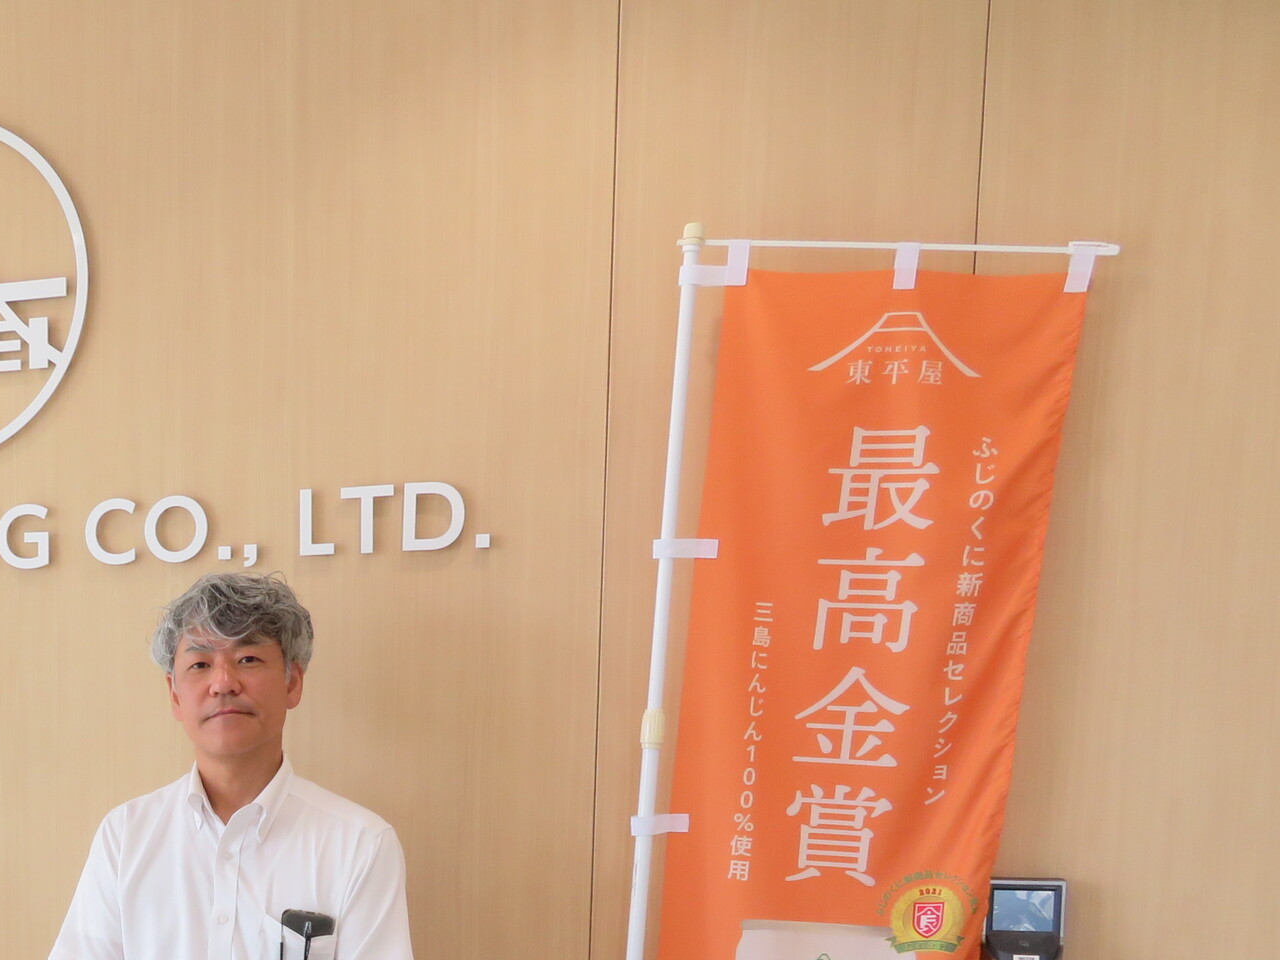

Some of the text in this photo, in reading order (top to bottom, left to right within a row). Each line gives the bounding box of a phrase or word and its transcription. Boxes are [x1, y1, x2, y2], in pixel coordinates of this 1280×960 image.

[845, 358, 944, 386] 東平屋
[866, 345, 928, 354] TOHEIYA
[84, 494, 258, 568] CO.,
[298, 481, 492, 557] LTD.
[784, 425, 941, 887] 最高金賞
[924, 437, 999, 805] ふじのくに新商品セレクション
[727, 601, 774, 882] 三島にんじん100%使用
